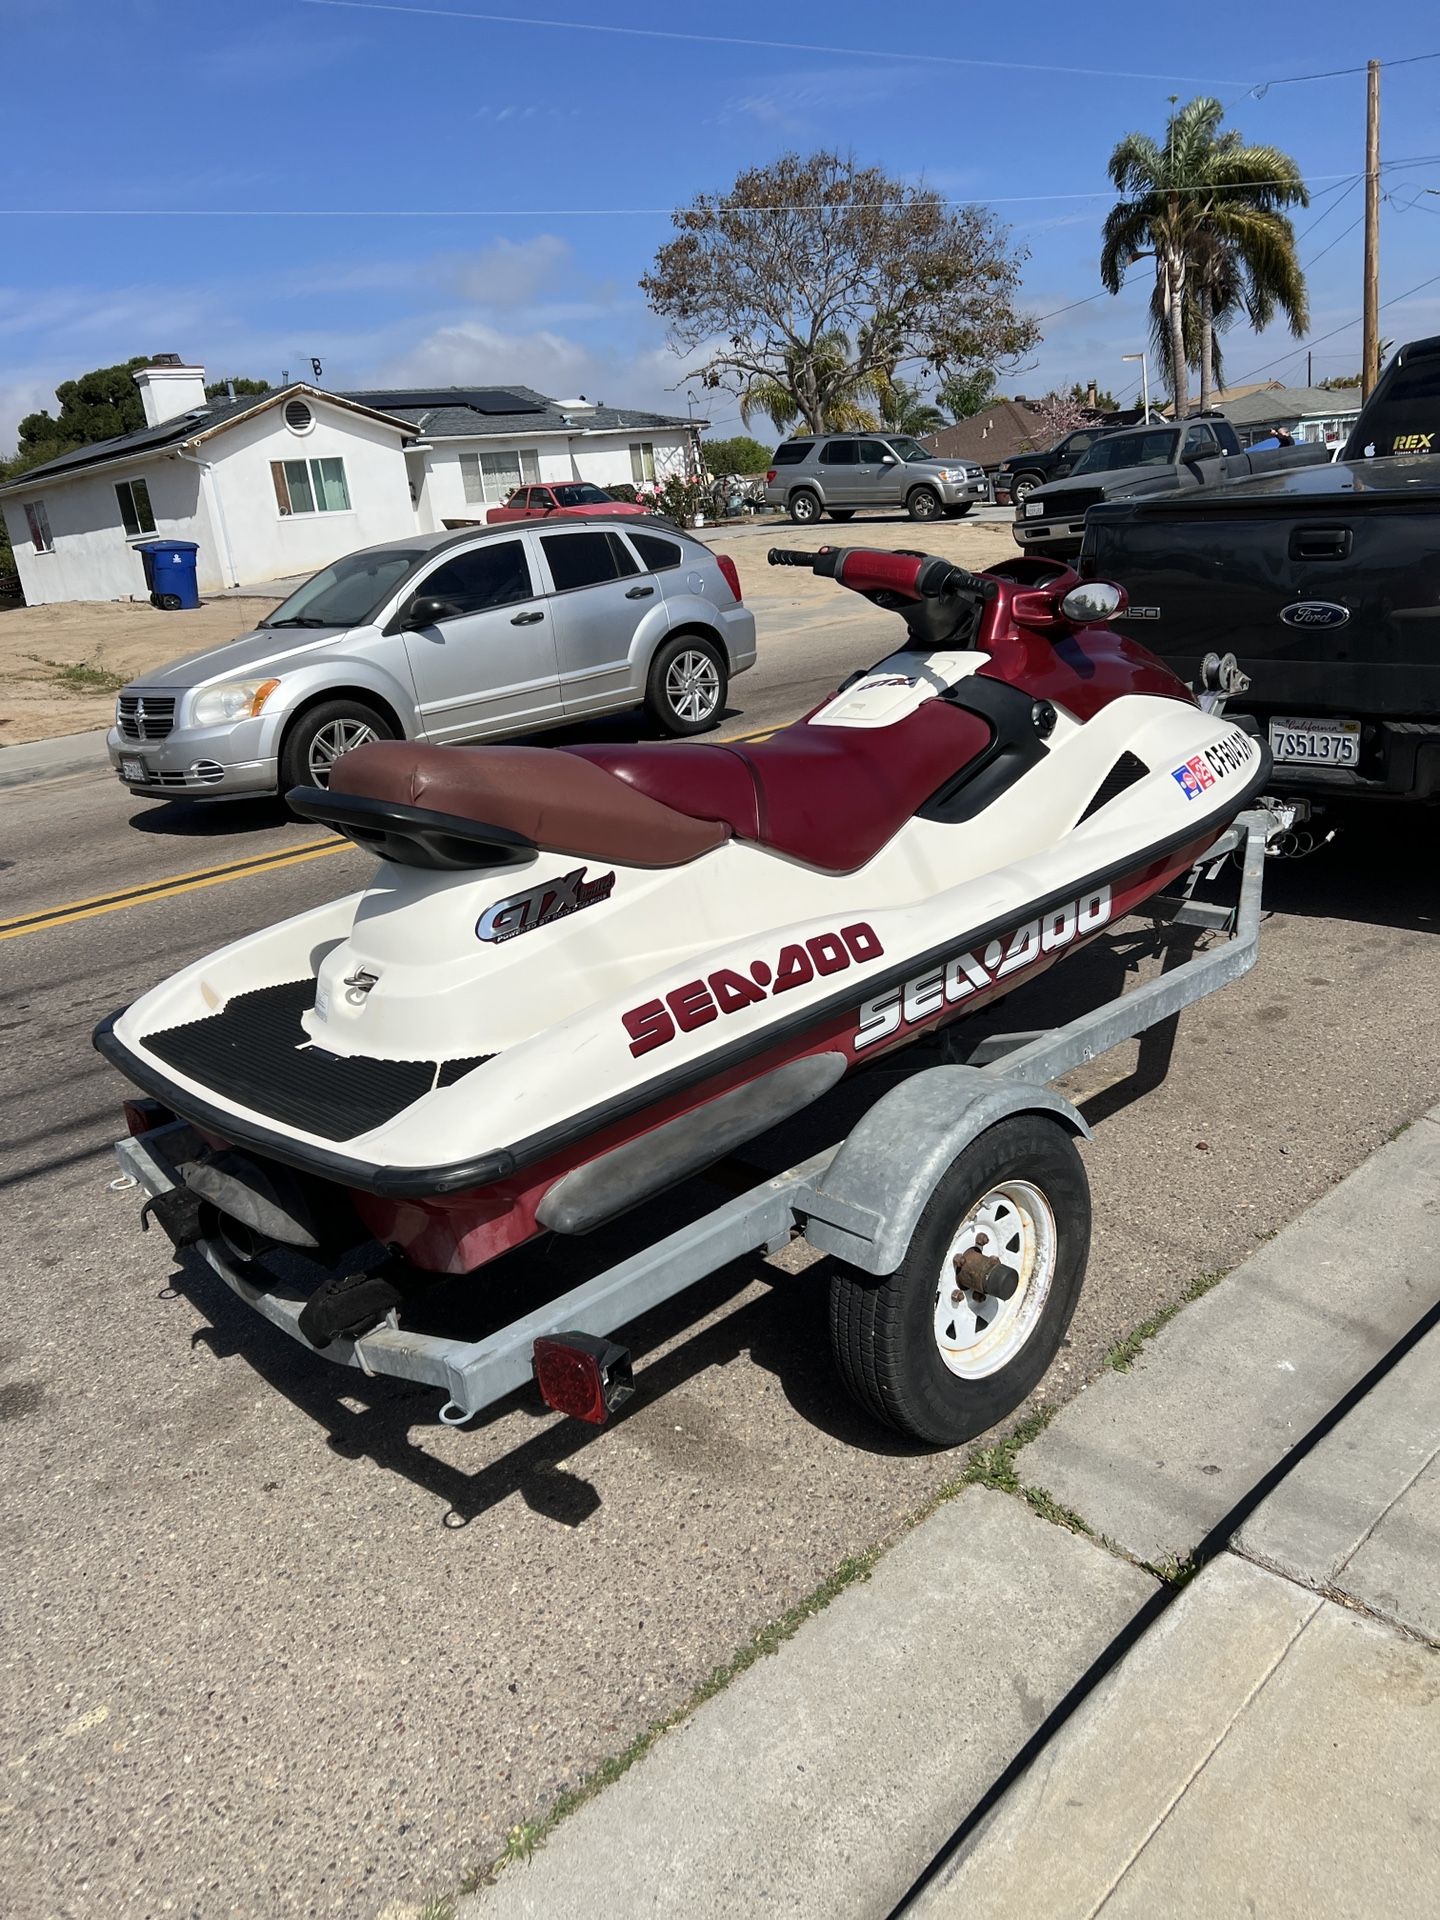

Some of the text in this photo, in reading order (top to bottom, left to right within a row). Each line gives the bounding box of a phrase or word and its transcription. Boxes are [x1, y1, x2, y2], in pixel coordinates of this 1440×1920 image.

[1393, 433, 1435, 450] REX
[1294, 607, 1331, 623] Ford
[1288, 720, 1338, 733] California
[1274, 733, 1353, 760] 7S51375
[477, 866, 587, 941] GTX
